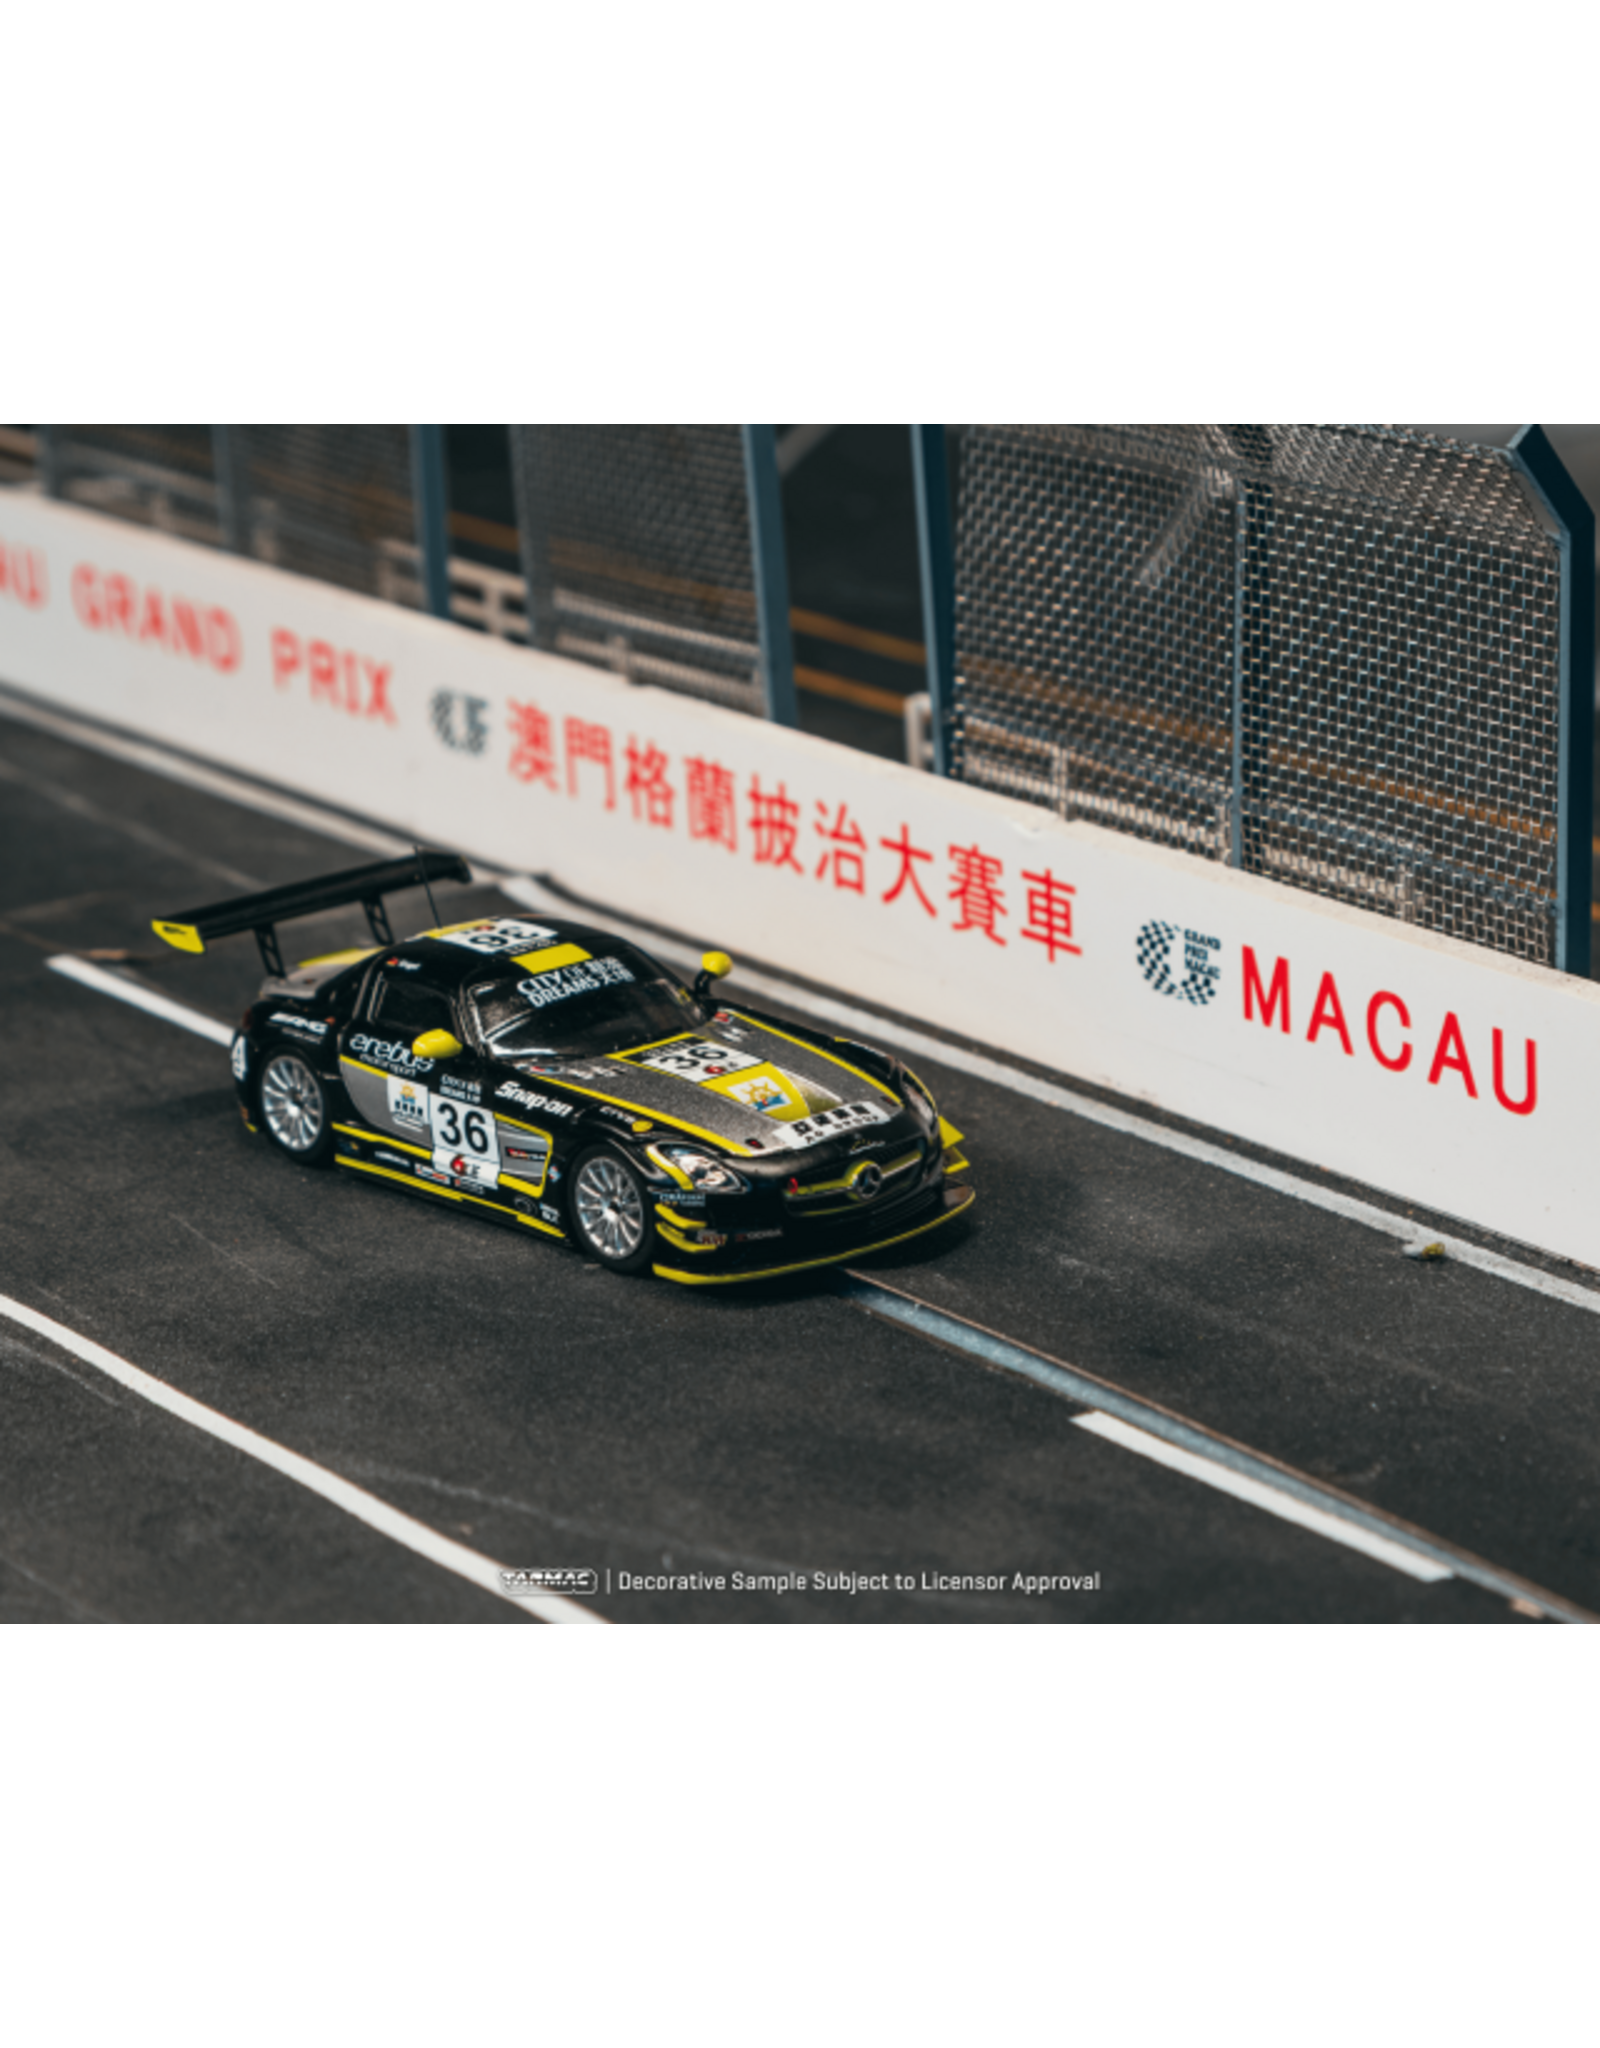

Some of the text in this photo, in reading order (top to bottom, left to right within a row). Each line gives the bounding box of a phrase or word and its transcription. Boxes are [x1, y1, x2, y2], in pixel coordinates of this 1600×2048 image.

[70, 561, 243, 676] GRAND
[270, 626, 397, 727] PRIX
[506, 697, 1083, 964] 澳門格蘭披治大賽車
[1184, 928, 1220, 951] GRAND
[516, 970, 562, 995] CITY
[528, 976, 600, 1008] DREAMS
[1241, 944, 1537, 1116] MACAU
[660, 1046, 728, 1070] 36
[437, 1102, 488, 1154] 36
